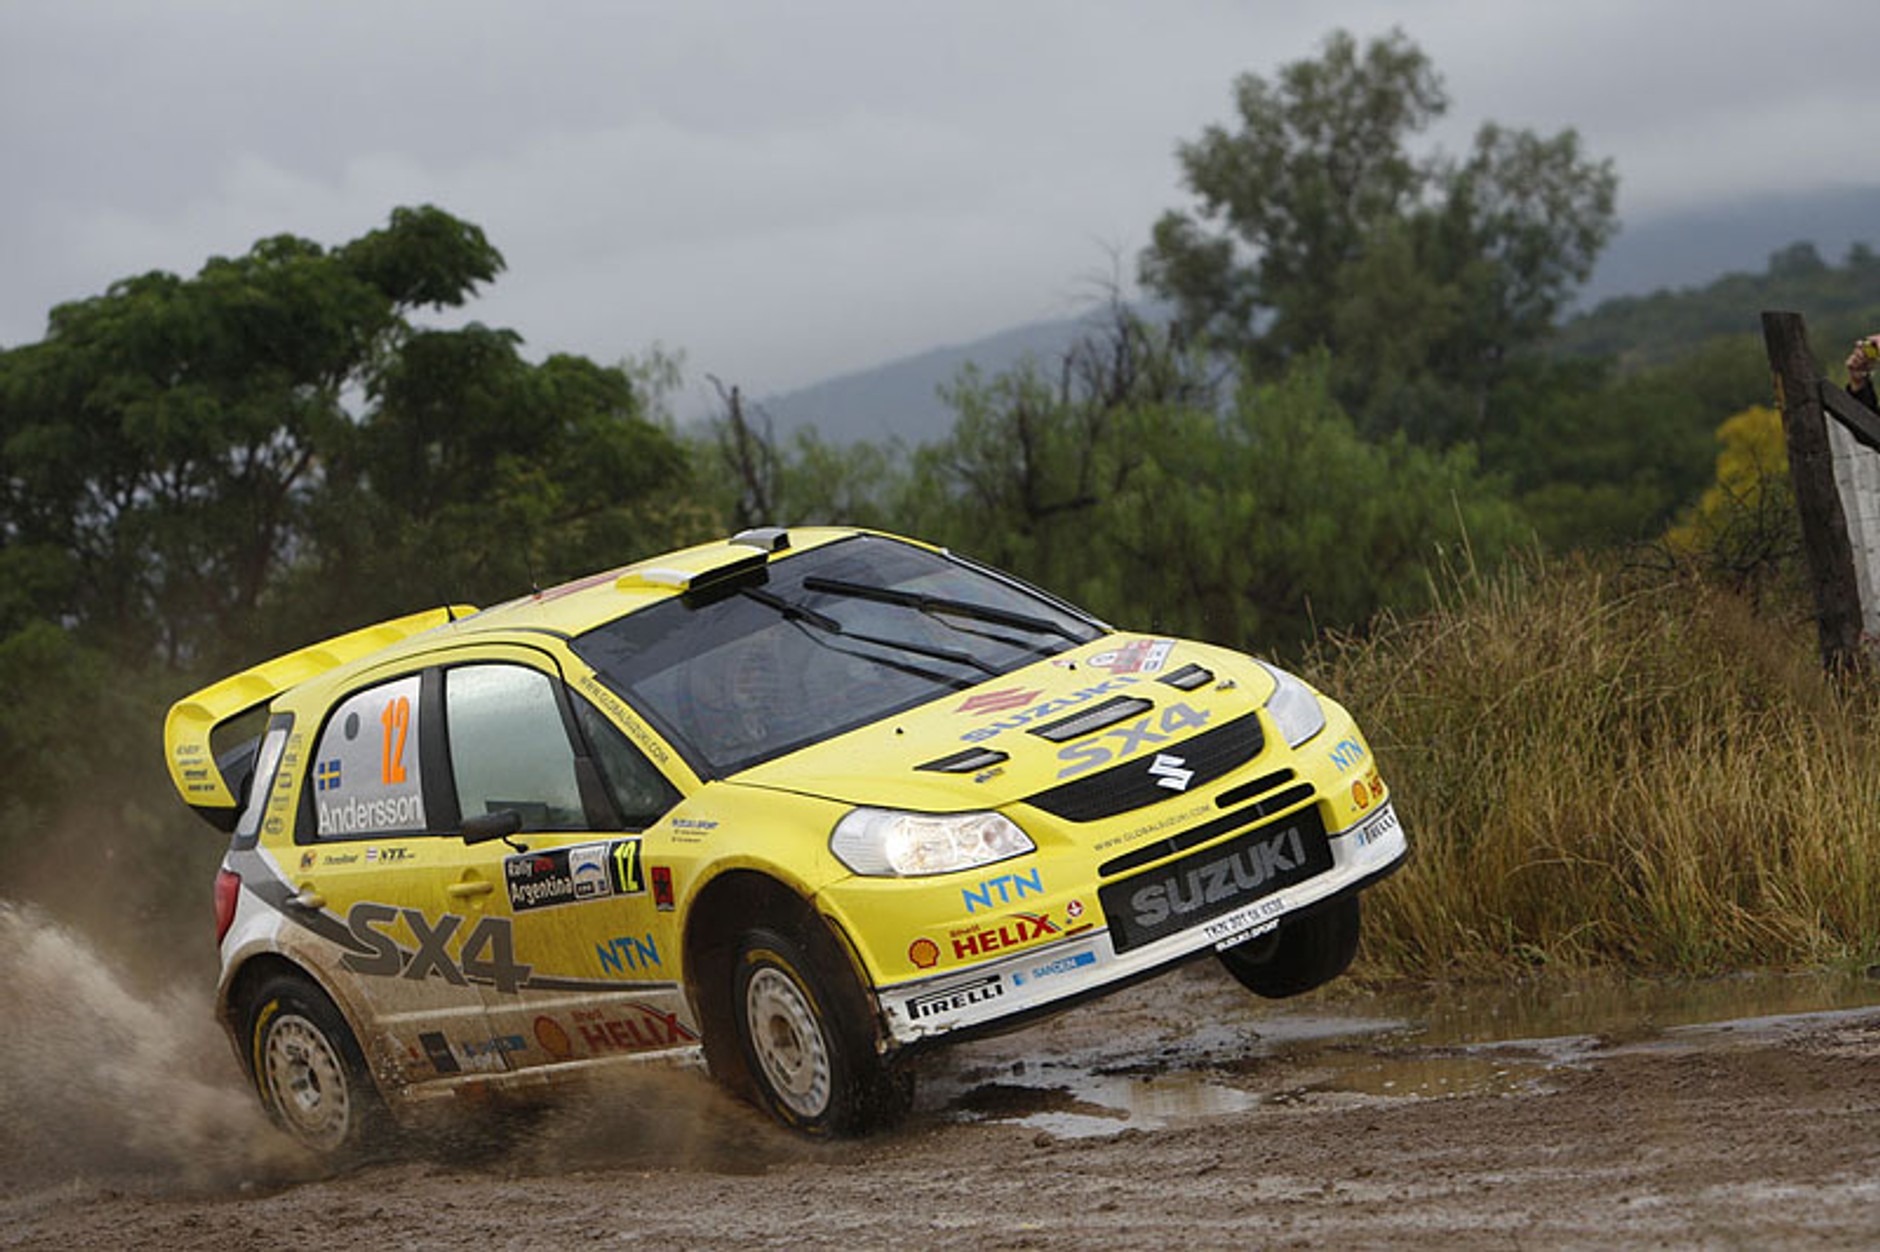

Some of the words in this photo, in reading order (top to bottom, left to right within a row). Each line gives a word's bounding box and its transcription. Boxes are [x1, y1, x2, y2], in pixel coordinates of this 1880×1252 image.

[959, 676, 1140, 743] SUZUKI
[380, 696, 410, 785] 12
[1056, 702, 1211, 779] SX4
[1329, 736, 1364, 772] NTN
[318, 793, 424, 835] Andersson
[507, 858, 533, 878] Rally
[510, 874, 574, 905] Argentina
[613, 840, 640, 893] 12
[1129, 826, 1307, 928] SUZUKI
[961, 867, 1045, 914] NTN
[339, 902, 533, 995] SX4
[595, 932, 662, 976] NTN
[951, 912, 1058, 960] HELIX
[905, 973, 1004, 1020] PIRELLI
[576, 1011, 696, 1055] HELIX
